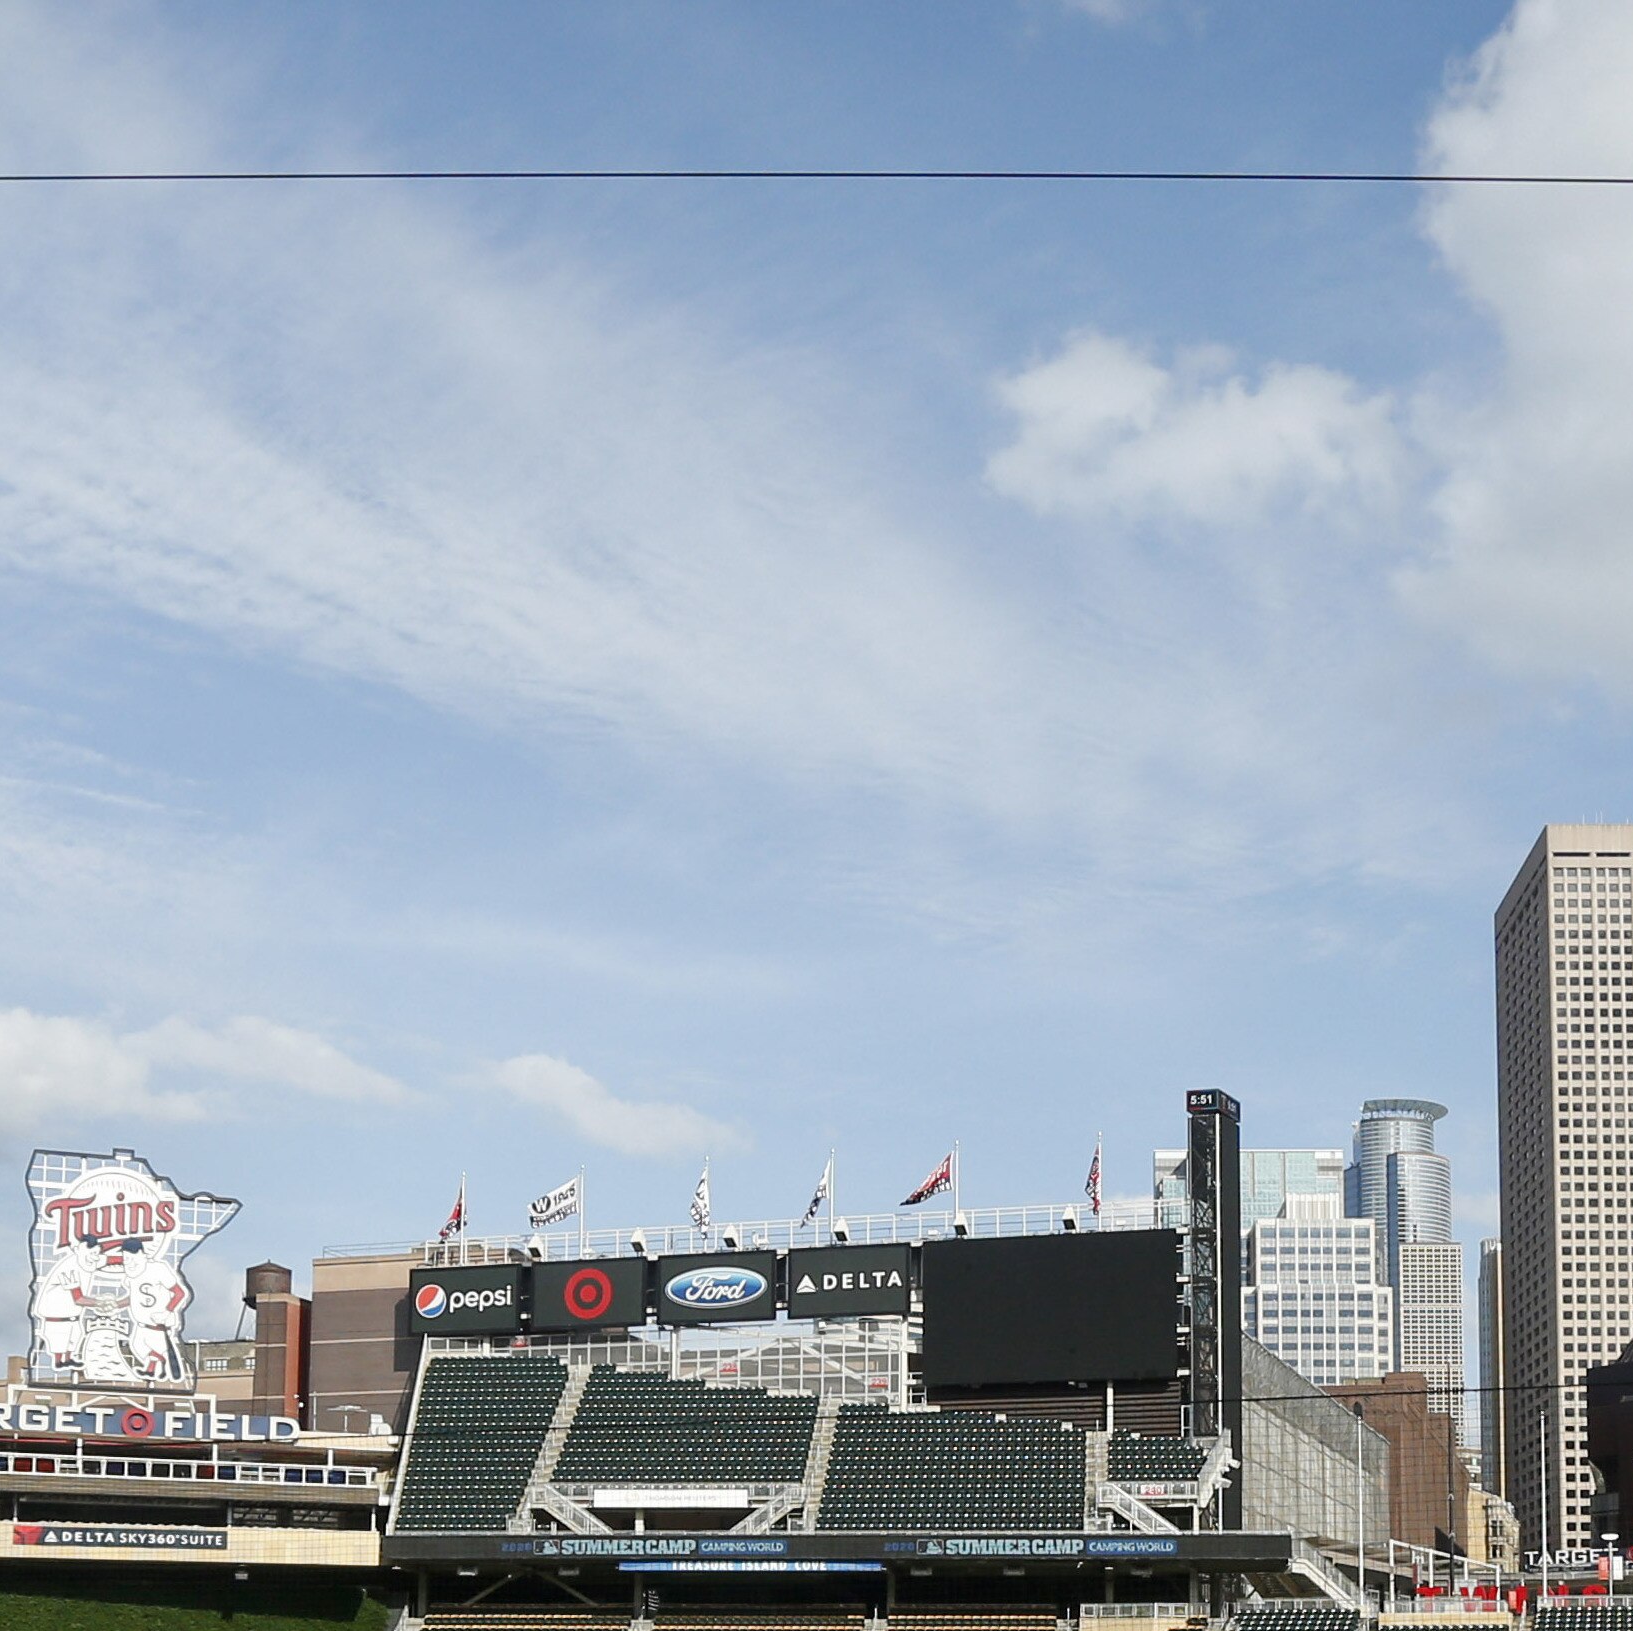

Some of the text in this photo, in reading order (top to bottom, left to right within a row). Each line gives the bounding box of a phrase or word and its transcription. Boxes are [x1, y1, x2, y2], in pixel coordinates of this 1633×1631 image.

[1190, 1094, 1213, 1105] 5:51
[45, 1192, 176, 1248] Twins
[685, 1274, 749, 1301] Ford
[823, 1270, 903, 1291] DELTA
[449, 1285, 512, 1313] pepsi
[165, 1411, 300, 1443] FIELD
[63, 1531, 115, 1544] DELTA
[181, 1534, 223, 1547] SUITE
[561, 1540, 644, 1555] SUMMER
[644, 1539, 697, 1555] CAMP
[701, 1542, 746, 1552] CAMPING
[747, 1542, 785, 1552] WORLD
[945, 1540, 1031, 1555] SUMMER
[1031, 1539, 1084, 1554] CAMP
[1089, 1542, 1136, 1552] CAMPING
[1136, 1542, 1175, 1552] WORLD
[1525, 1547, 1618, 1565] TARGET
[672, 1562, 827, 1571] TREASURE ISLAND COVE
